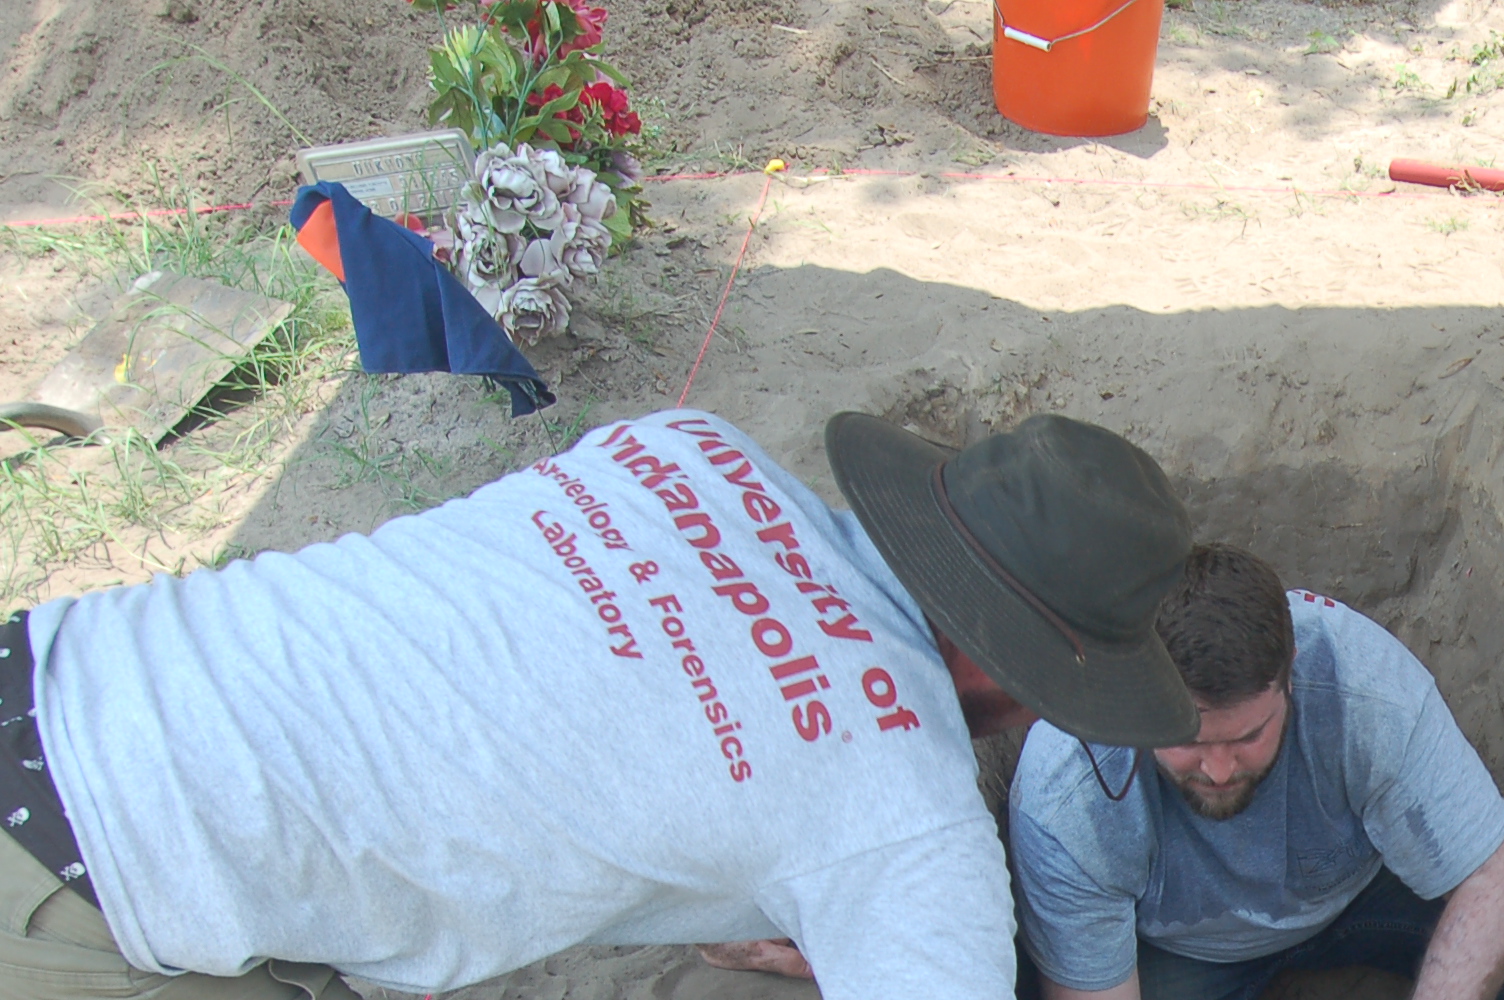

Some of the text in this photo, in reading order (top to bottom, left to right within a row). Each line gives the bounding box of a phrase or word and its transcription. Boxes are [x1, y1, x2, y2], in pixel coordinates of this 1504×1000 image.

[530, 510, 644, 660] Laboratory
[597, 424, 832, 742] Indianapolis
[628, 560, 659, 584] &
[648, 594, 752, 783] Forensics
[666, 419, 920, 731] University of
